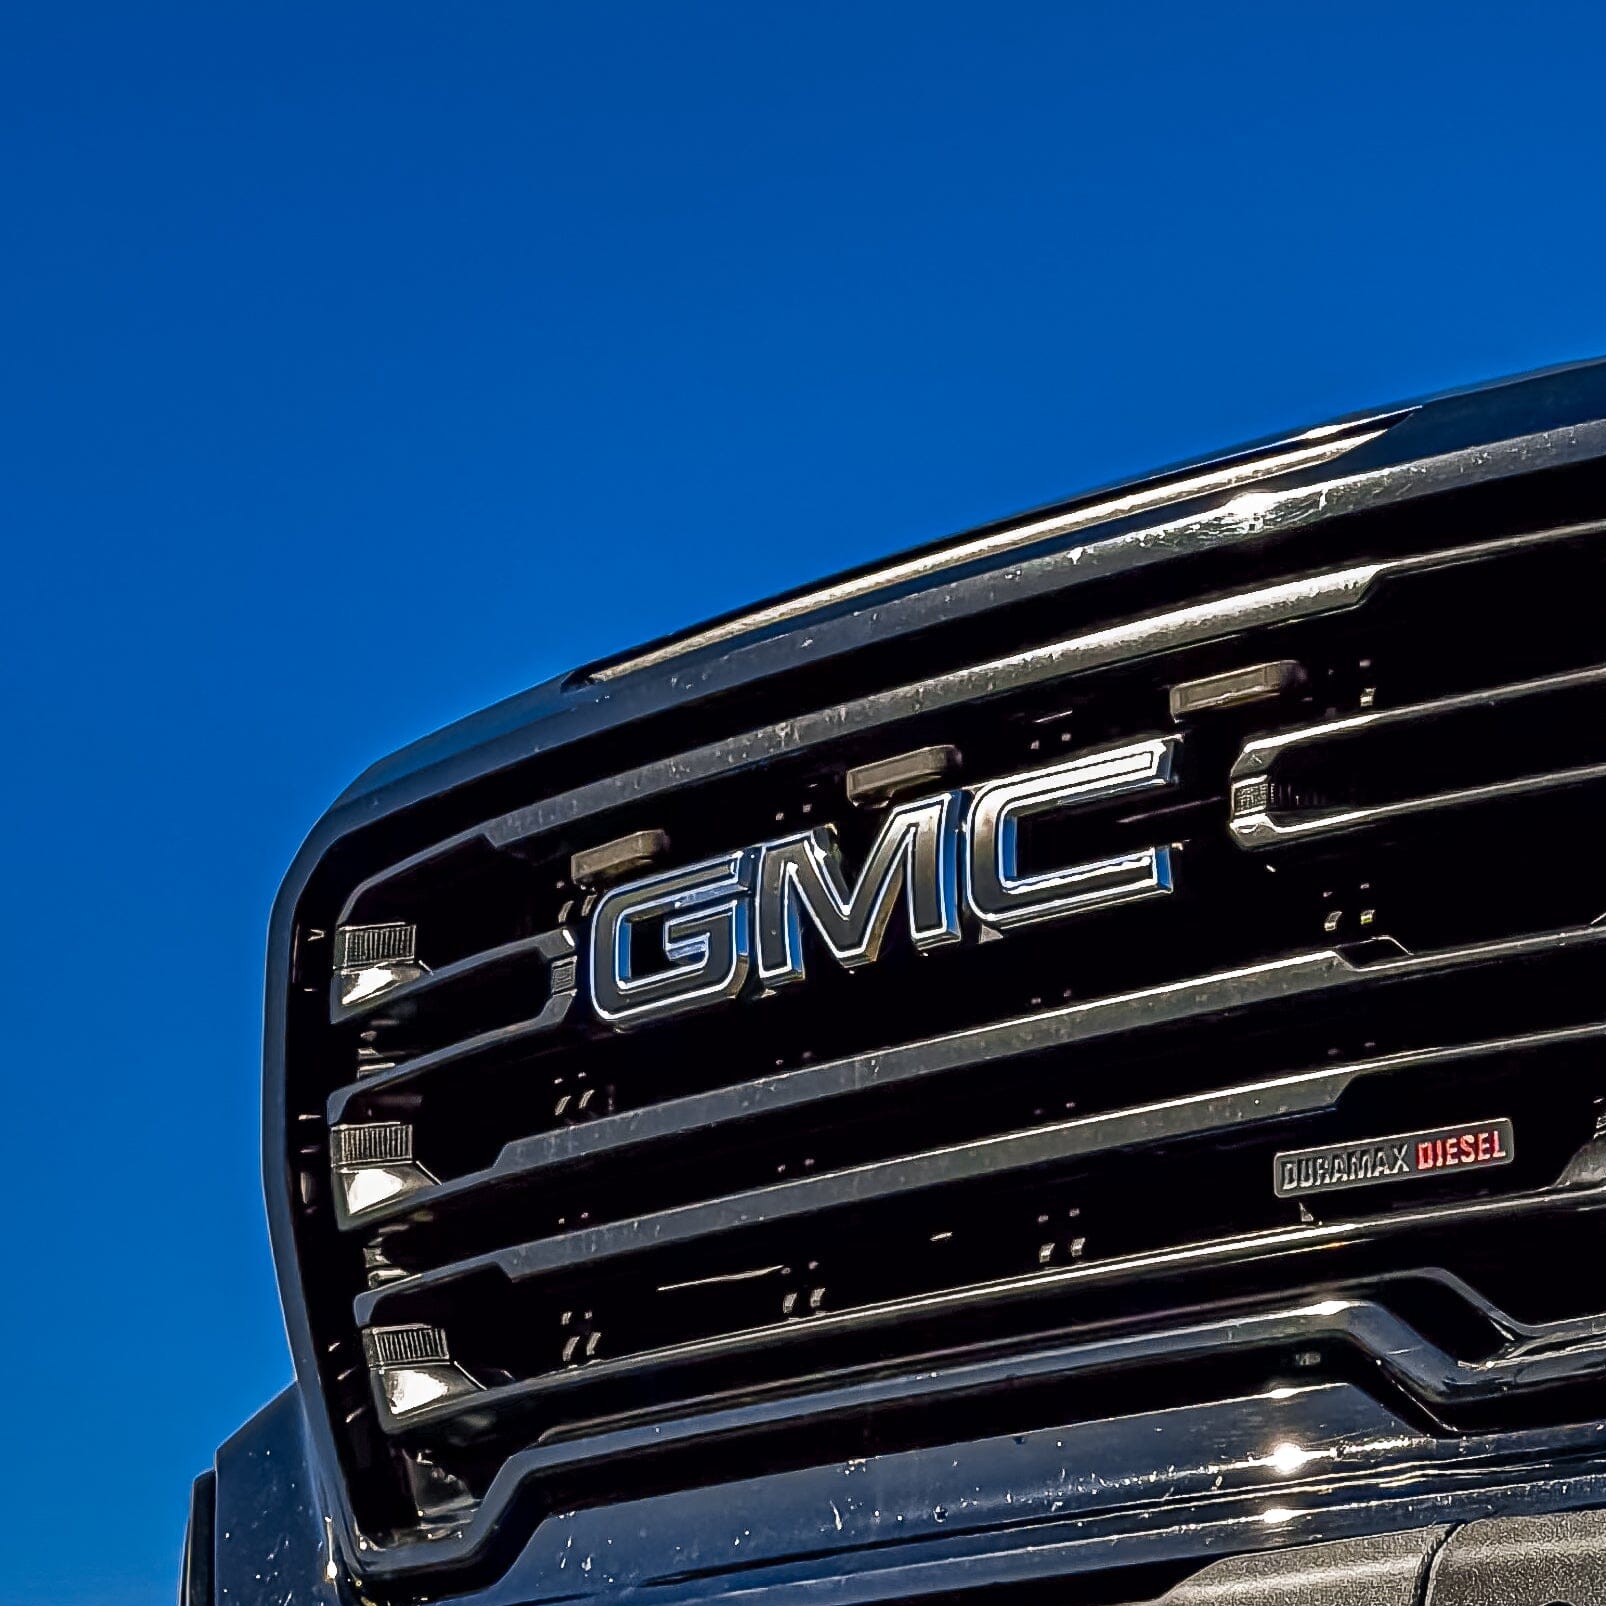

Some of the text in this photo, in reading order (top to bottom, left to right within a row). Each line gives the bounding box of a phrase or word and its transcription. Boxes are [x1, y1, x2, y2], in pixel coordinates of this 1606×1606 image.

[591, 735, 1184, 1025] GMC
[1281, 1130, 1507, 1191] DURAMAX DIESEL
